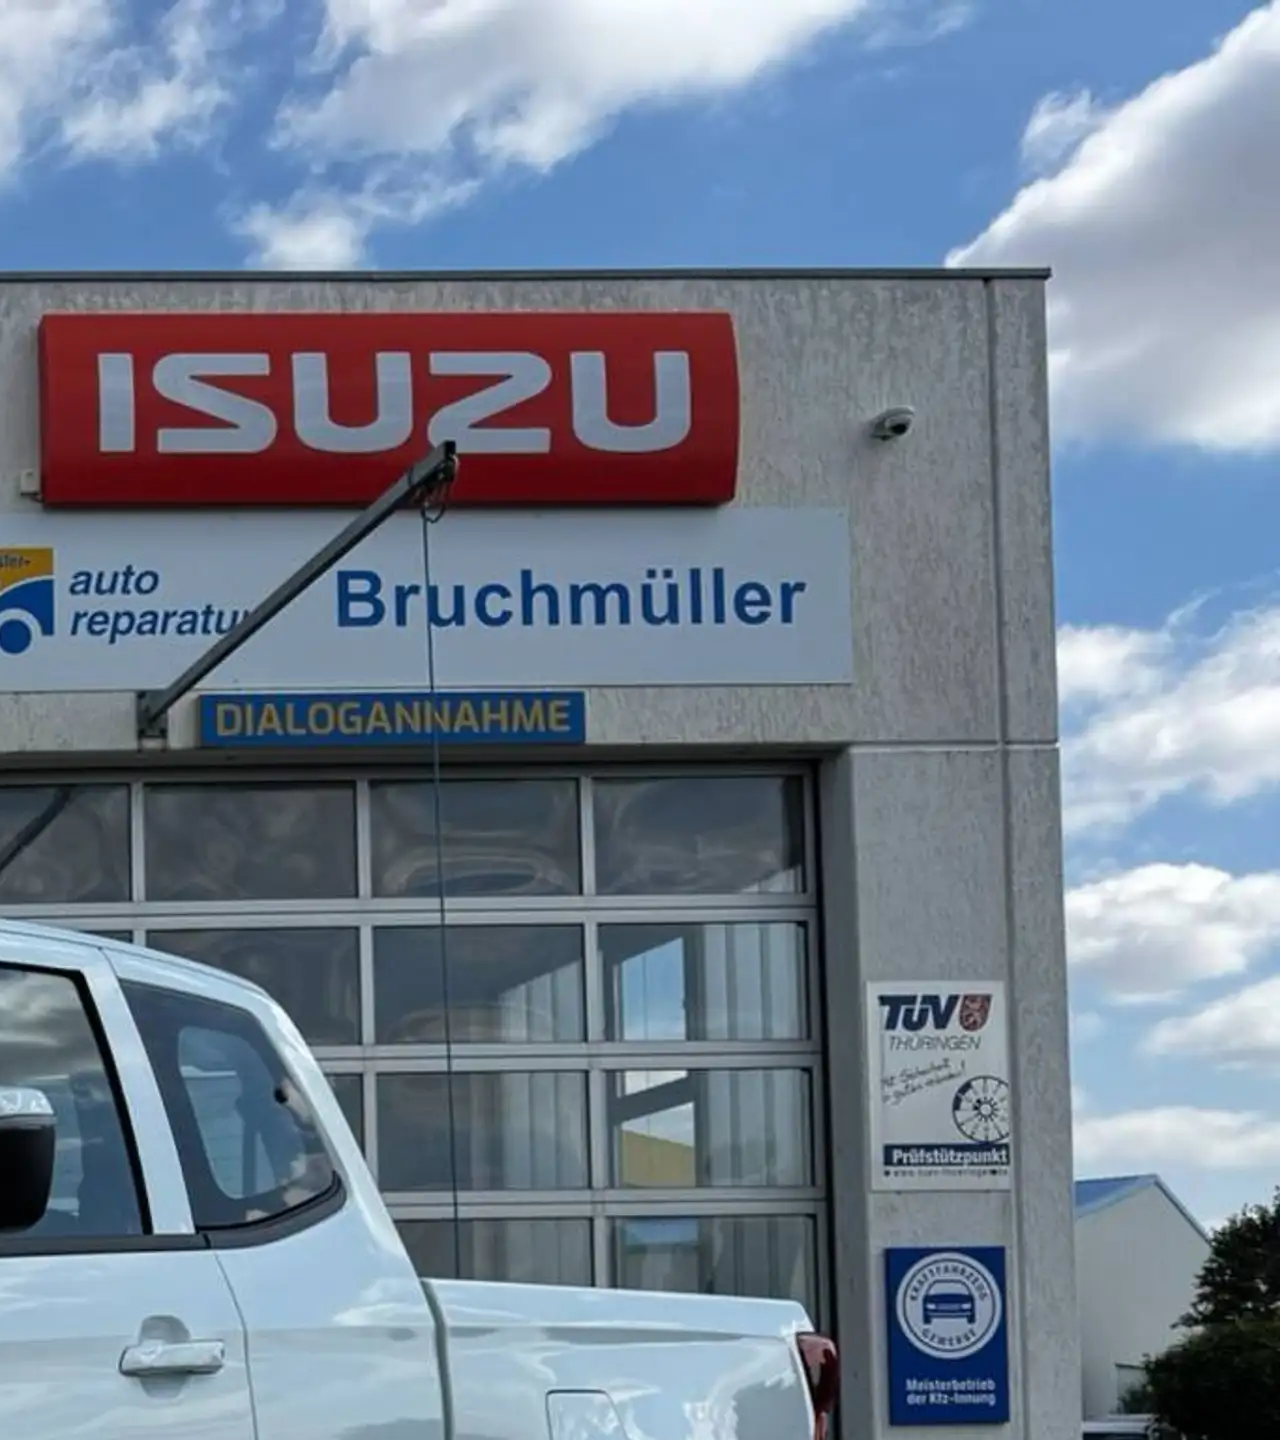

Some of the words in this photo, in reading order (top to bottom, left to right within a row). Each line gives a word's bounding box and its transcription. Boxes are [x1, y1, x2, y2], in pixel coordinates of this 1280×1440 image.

[96, 350, 692, 455] ISUZU
[68, 564, 159, 596] auto
[336, 567, 806, 628] Bruchmüller
[69, 603, 256, 644] reparatu
[216, 699, 572, 736] DIALOGANNAHME
[891, 1034, 982, 1051] THÜRINGEN
[891, 1147, 1008, 1169] Prüfstützpunkt
